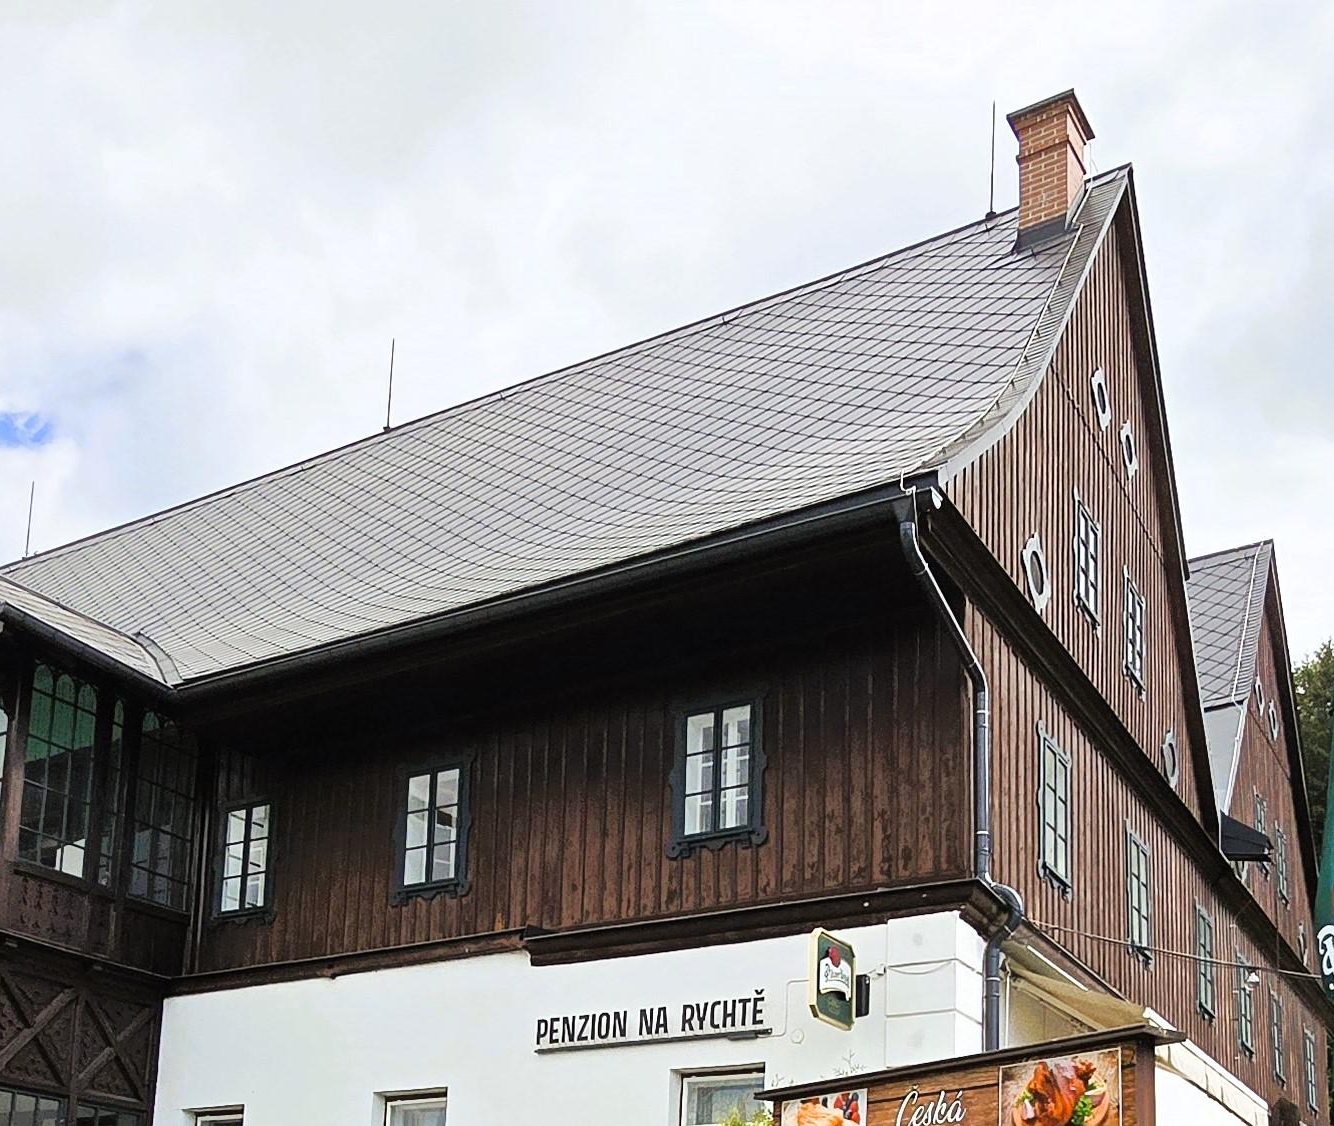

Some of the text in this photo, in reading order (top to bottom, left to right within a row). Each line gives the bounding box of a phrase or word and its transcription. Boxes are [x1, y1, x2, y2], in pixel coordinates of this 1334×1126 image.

[536, 988, 766, 1046] PENZION NA RYCHTĚ
